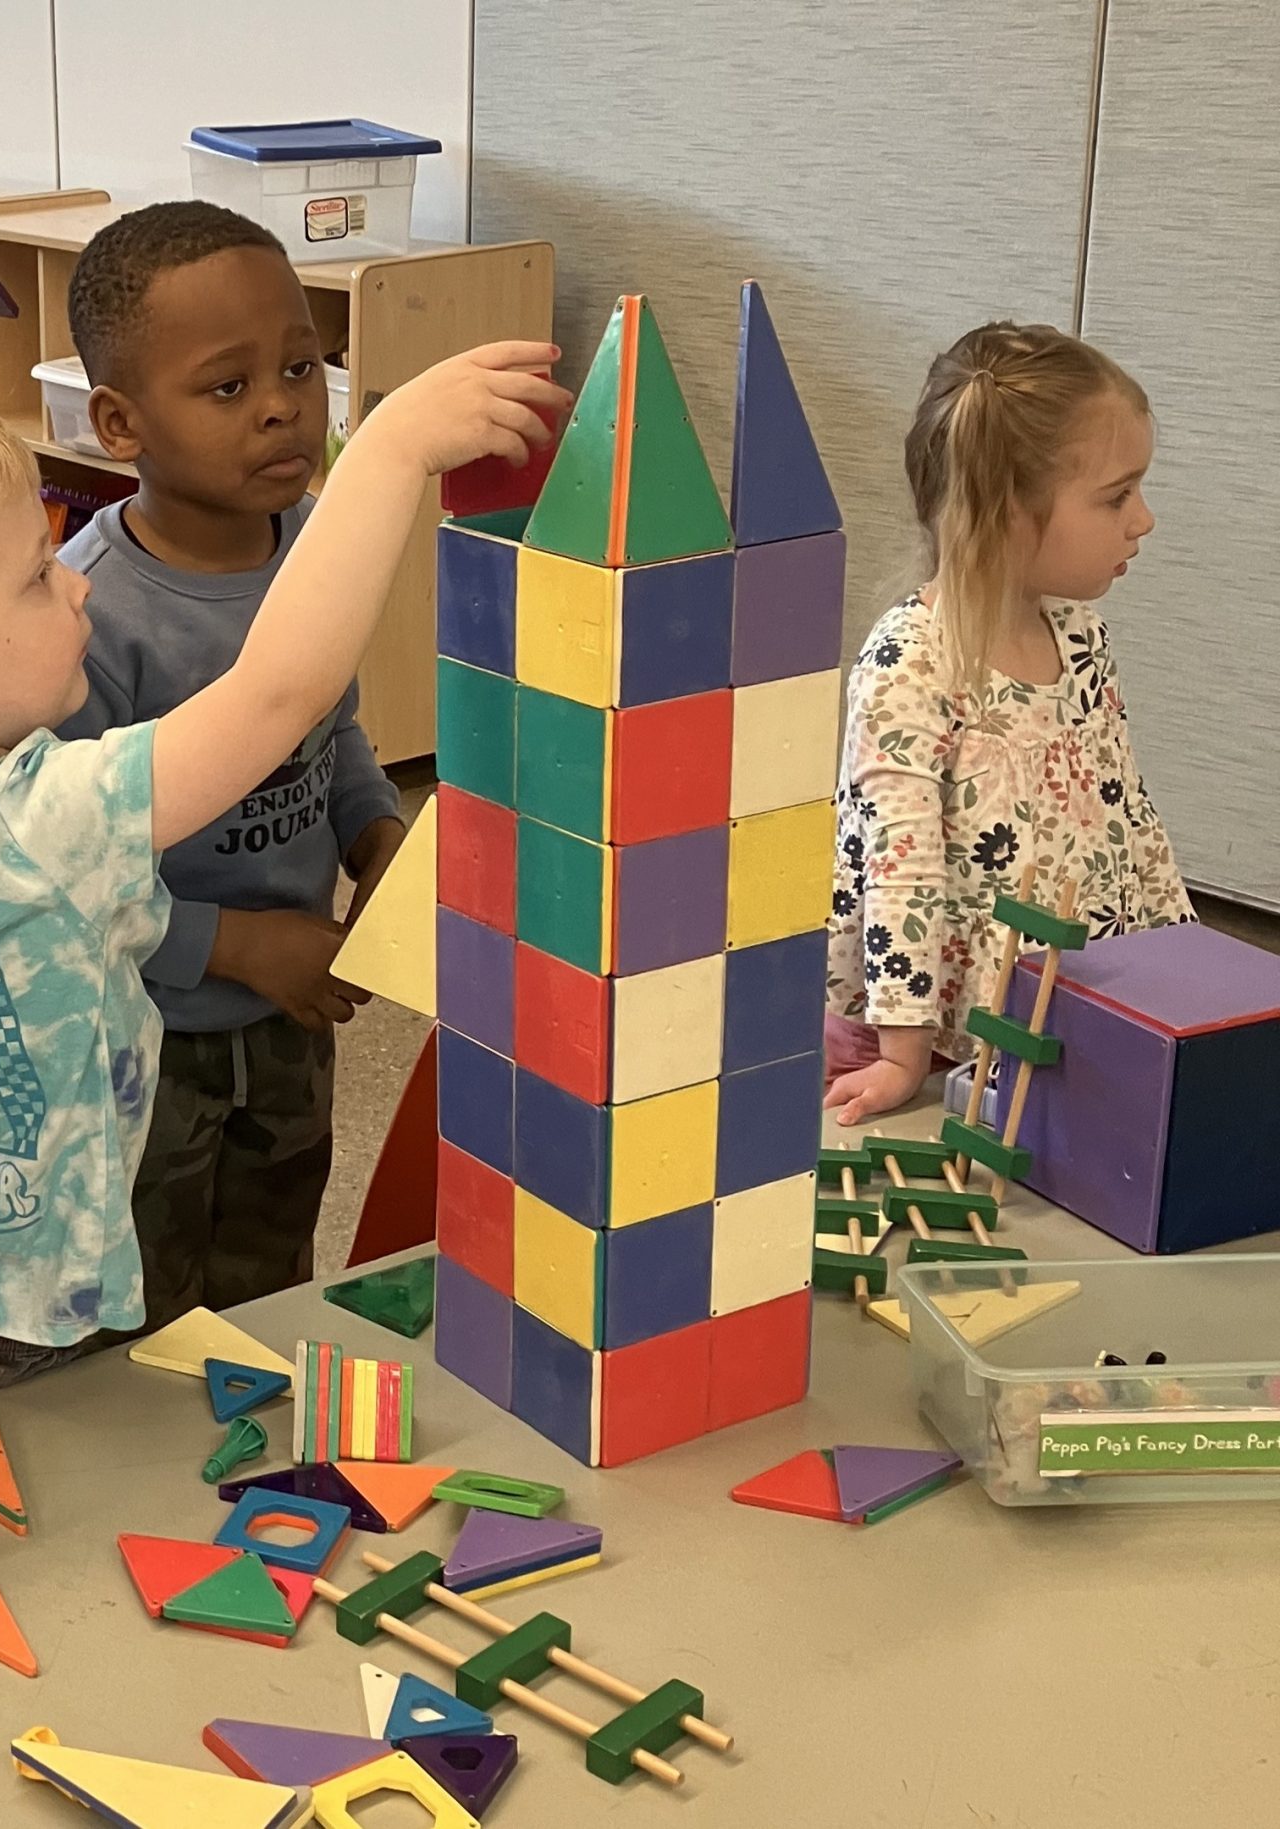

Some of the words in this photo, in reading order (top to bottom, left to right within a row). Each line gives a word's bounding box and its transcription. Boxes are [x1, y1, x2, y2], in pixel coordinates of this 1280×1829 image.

[241, 773, 312, 819] ENJOY
[1042, 1437, 1090, 1457] Peppa
[1096, 1436, 1131, 1456] Pig's
[1137, 1434, 1187, 1455] Fancy
[1194, 1434, 1241, 1450] Dress
